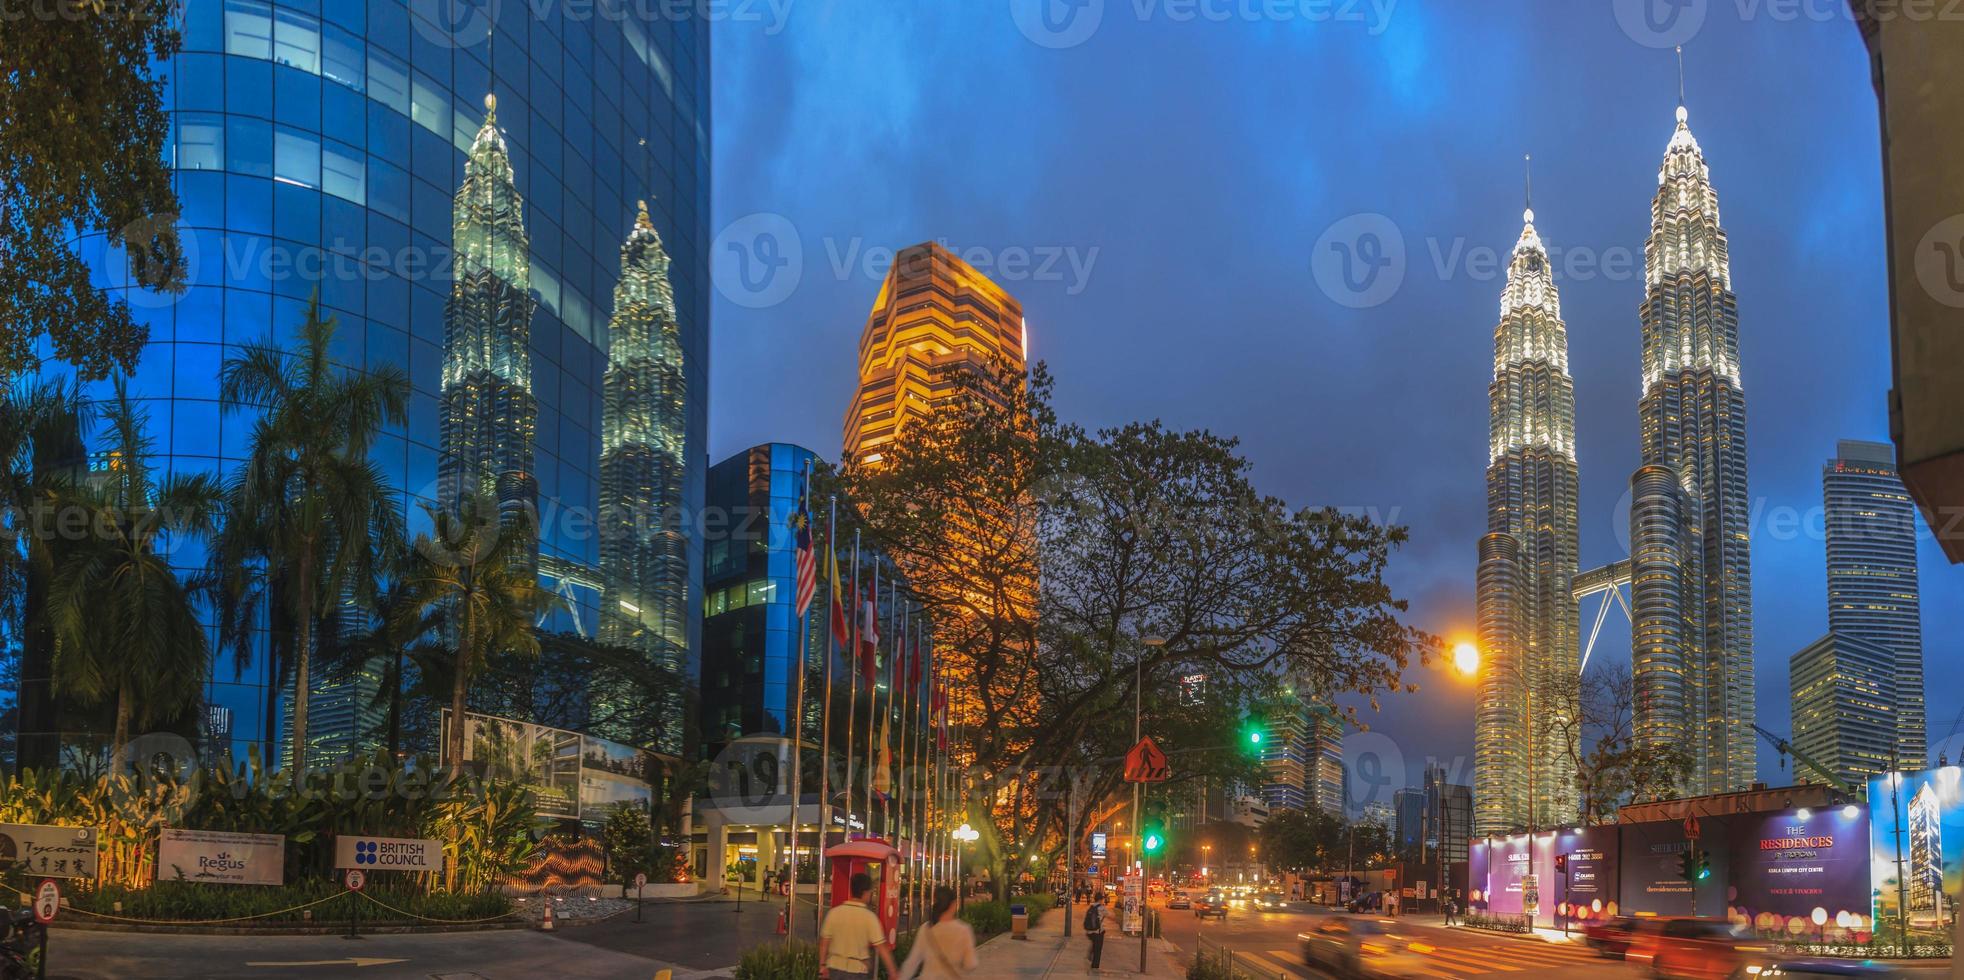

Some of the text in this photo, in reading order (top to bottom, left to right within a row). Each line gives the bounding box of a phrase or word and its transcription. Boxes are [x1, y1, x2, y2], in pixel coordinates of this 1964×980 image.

[1786, 826, 1805, 835] THE
[23, 841, 91, 856] Tycoon
[380, 842, 424, 854] BRITISH
[1760, 836, 1833, 849] RESIDENCES
[199, 856, 245, 871] Regus
[379, 854, 426, 866] COUNCIL
